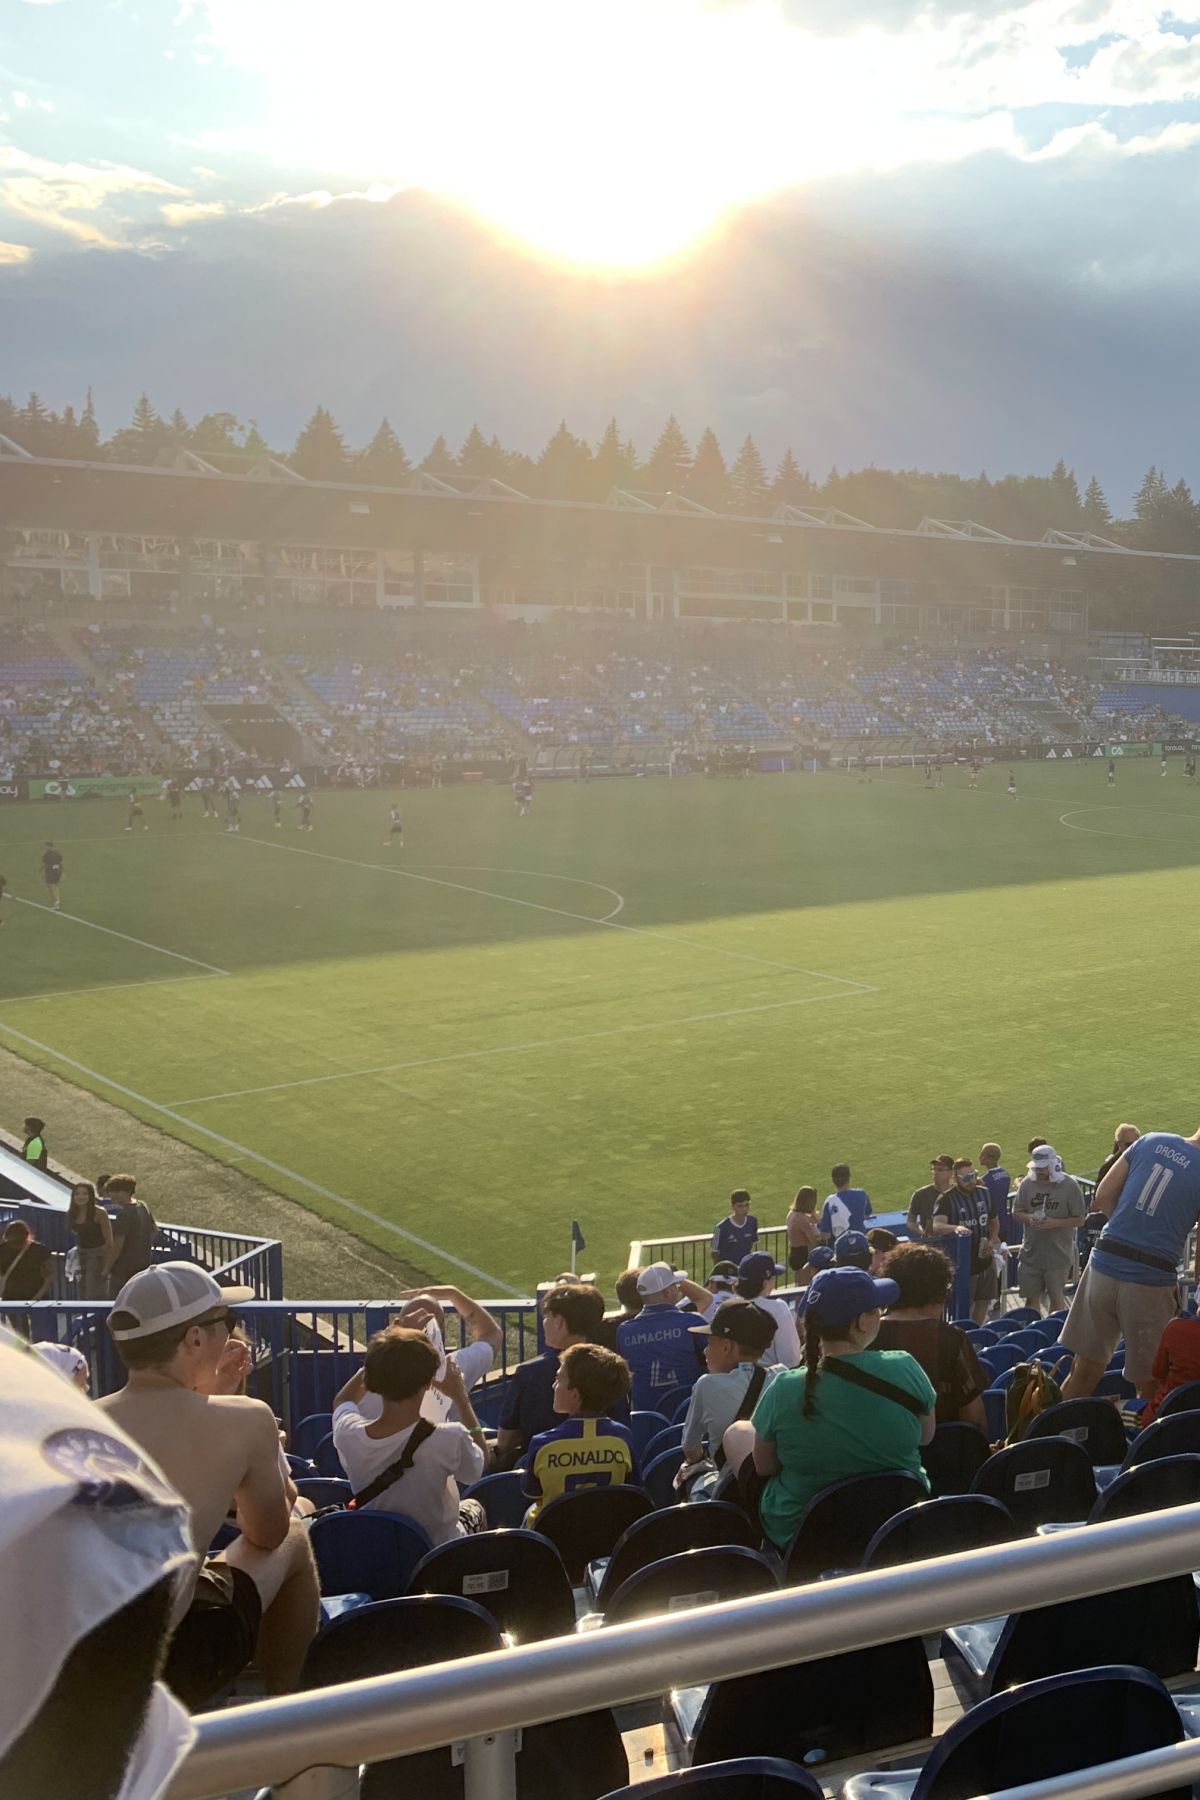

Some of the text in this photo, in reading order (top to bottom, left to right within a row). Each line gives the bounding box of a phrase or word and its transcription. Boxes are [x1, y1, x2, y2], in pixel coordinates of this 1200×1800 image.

[1155, 1144, 1191, 1169] DROGBA
[1135, 1162, 1174, 1217] 11
[624, 1327, 682, 1346] CAMACHO
[548, 1449, 625, 1468] RONALDO
